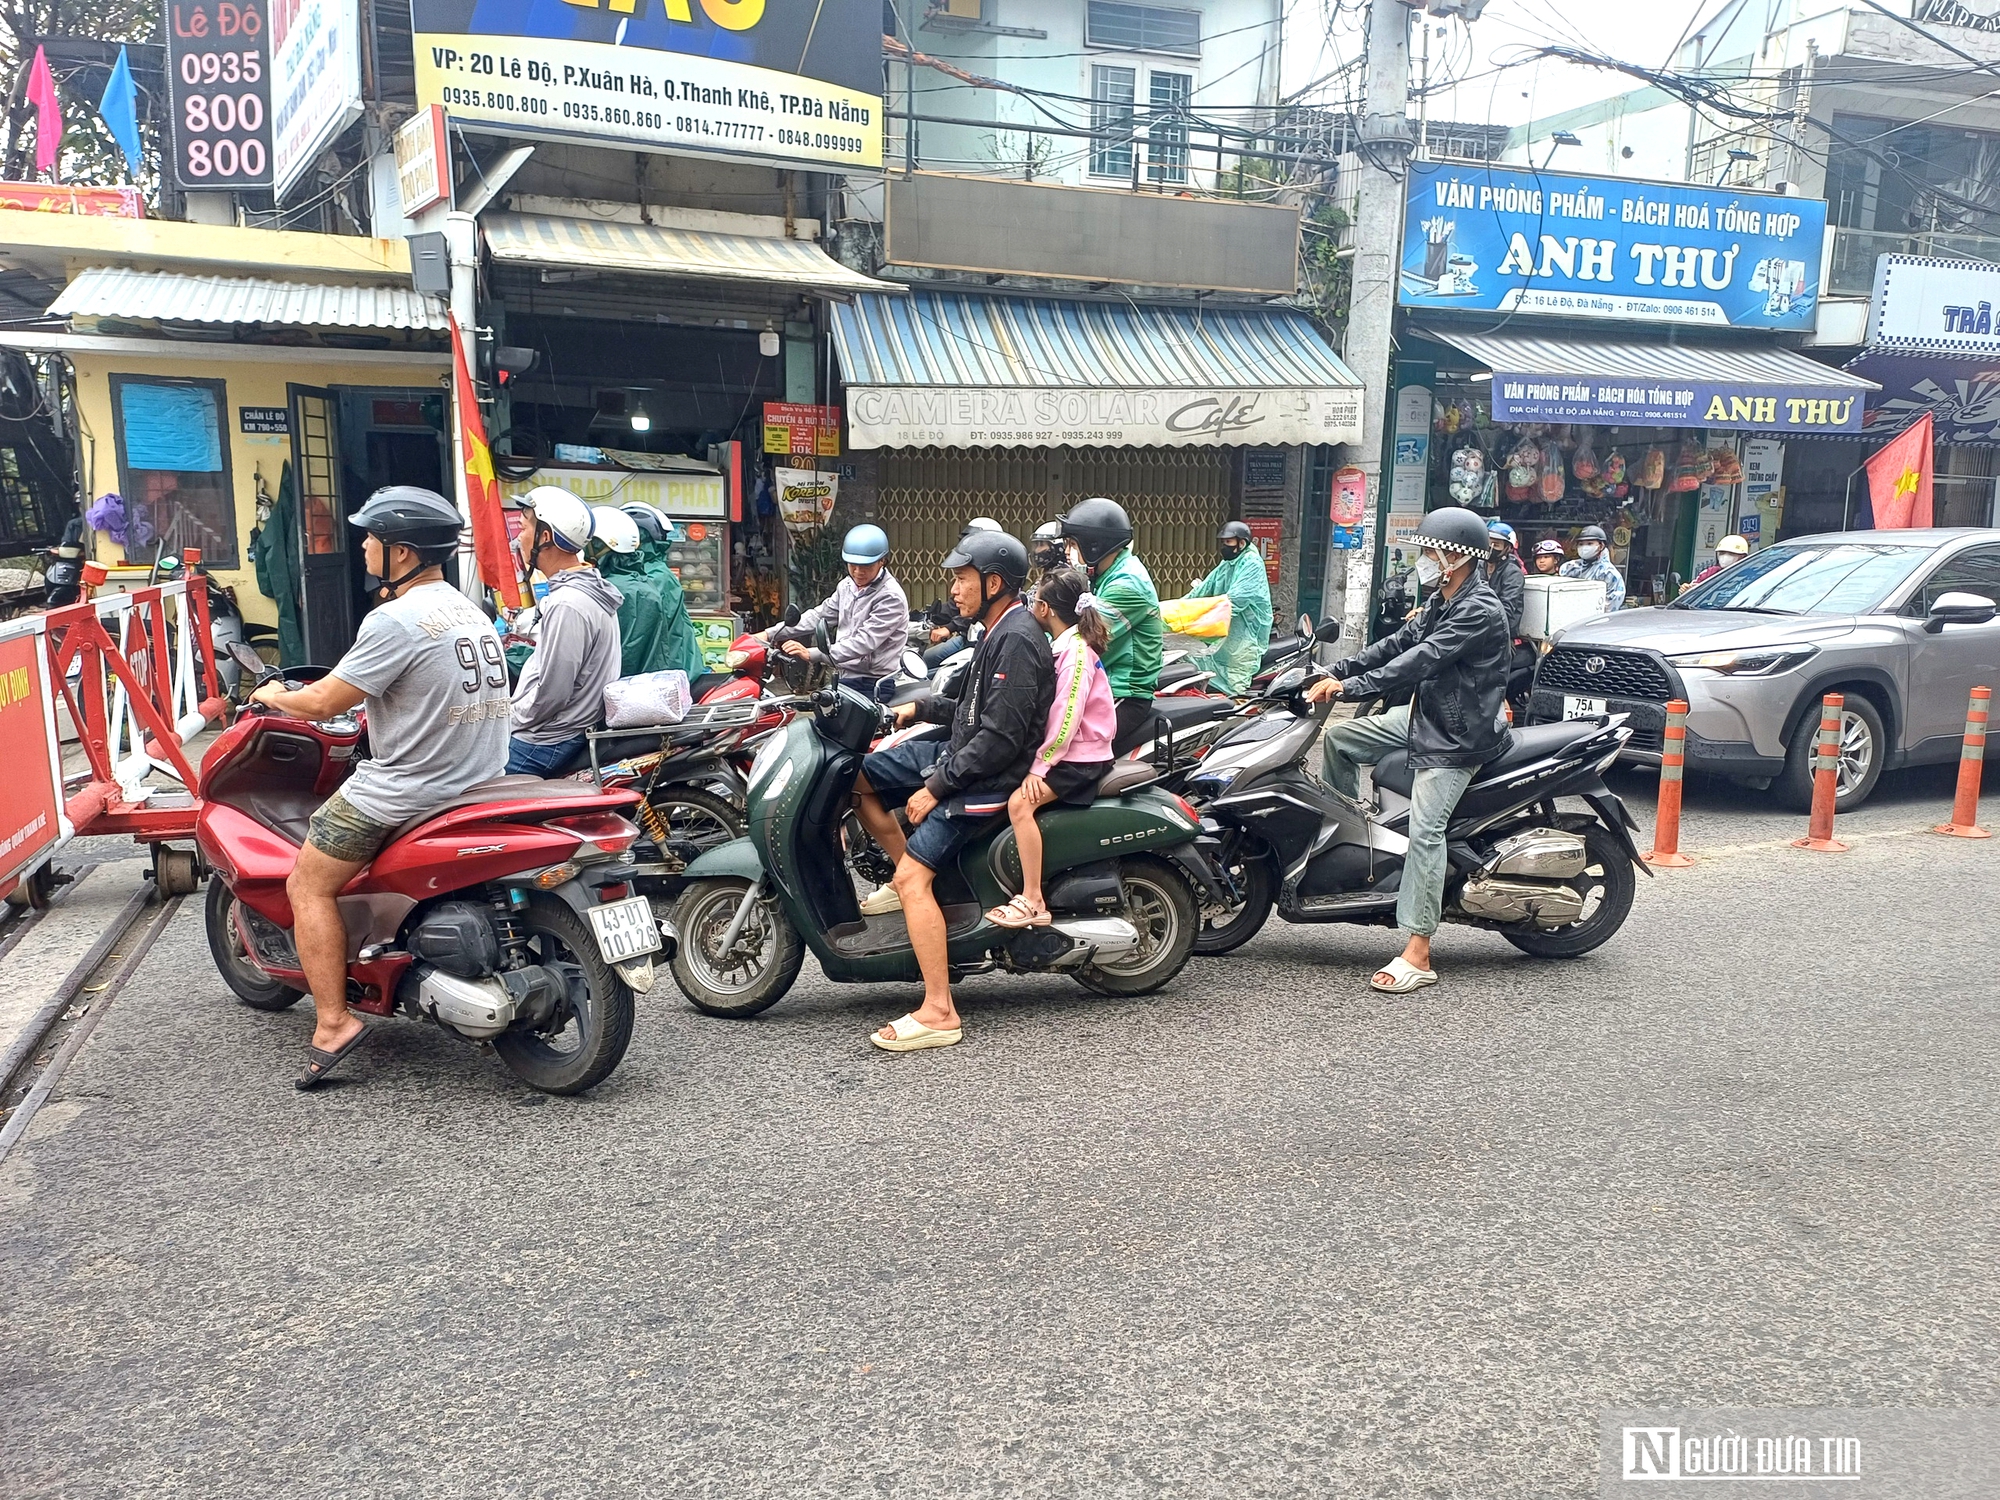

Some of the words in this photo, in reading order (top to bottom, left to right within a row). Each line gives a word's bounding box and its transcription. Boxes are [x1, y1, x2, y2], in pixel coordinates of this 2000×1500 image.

[174, 5, 209, 38] Lê
[217, 2, 262, 42] Độ
[181, 51, 261, 84] 0935
[432, 47, 464, 72] VP:
[470, 53, 493, 75] 20
[500, 56, 521, 78] Lê
[528, 60, 557, 87] Độ,
[564, 64, 624, 92] P.Xuân
[630, 72, 658, 99] Hà,
[664, 79, 732, 107] Q.Thanh
[738, 88, 775, 114] Khê,
[780, 94, 823, 118] TP.Đà
[829, 99, 870, 126] Nẵng
[185, 93, 263, 132] 800
[443, 86, 548, 115] 0935.800.800
[563, 102, 662, 129] 0935.860.860
[676, 116, 764, 141] 0814.777777
[778, 128, 862, 153] 0848.099999
[188, 138, 266, 177] 800
[1435, 177, 1475, 209] VĂN
[1479, 182, 1544, 216] PHÒNG
[1549, 185, 1605, 221] PHẨM
[1621, 195, 1670, 227] BÁCH
[1674, 202, 1710, 231] HOÁ
[1715, 200, 1762, 235] TỔNG
[1764, 212, 1800, 241] HỢP
[1496, 231, 1617, 282] ANH
[1630, 242, 1740, 291] THƯ
[1534, 296, 1544, 306] 16
[1577, 297, 1589, 308] Đà
[1626, 302, 1661, 314] ĐT/Zalo:
[1663, 305, 1683, 315] 0906
[1684, 306, 1699, 316] 461
[1701, 307, 1716, 317] 514
[855, 391, 1027, 426] CAMERA
[1034, 393, 1160, 426] SOLAR
[1504, 381, 1525, 400] VĂN
[1527, 382, 1560, 401] PHÒNG
[1561, 381, 1590, 402] PHẨM
[1598, 383, 1625, 404] BÁCH
[1627, 386, 1646, 405] HÓA
[1648, 385, 1673, 406] TỔNG
[1674, 389, 1695, 408] HỢP
[1544, 407, 1554, 415] 16
[1703, 394, 1777, 423] ANH
[1785, 395, 1855, 425] THƯ
[897, 431, 909, 440] 18
[970, 431, 987, 440] ĐT:
[990, 431, 1033, 441] 0935.986
[1035, 431, 1053, 441] 927
[1061, 431, 1104, 440] 0935.243
[1106, 431, 1123, 440] 999
[840, 465, 852, 476] 18
[455, 635, 506, 694] 99
[1069, 660, 1083, 699] MOVING
[1575, 698, 1593, 712] 75A
[1056, 705, 1073, 744] MOVING
[1044, 746, 1056, 761] MO
[1100, 826, 1168, 846] SCOOPY
[601, 903, 644, 932] 43-D1
[603, 925, 657, 957] 101.26
